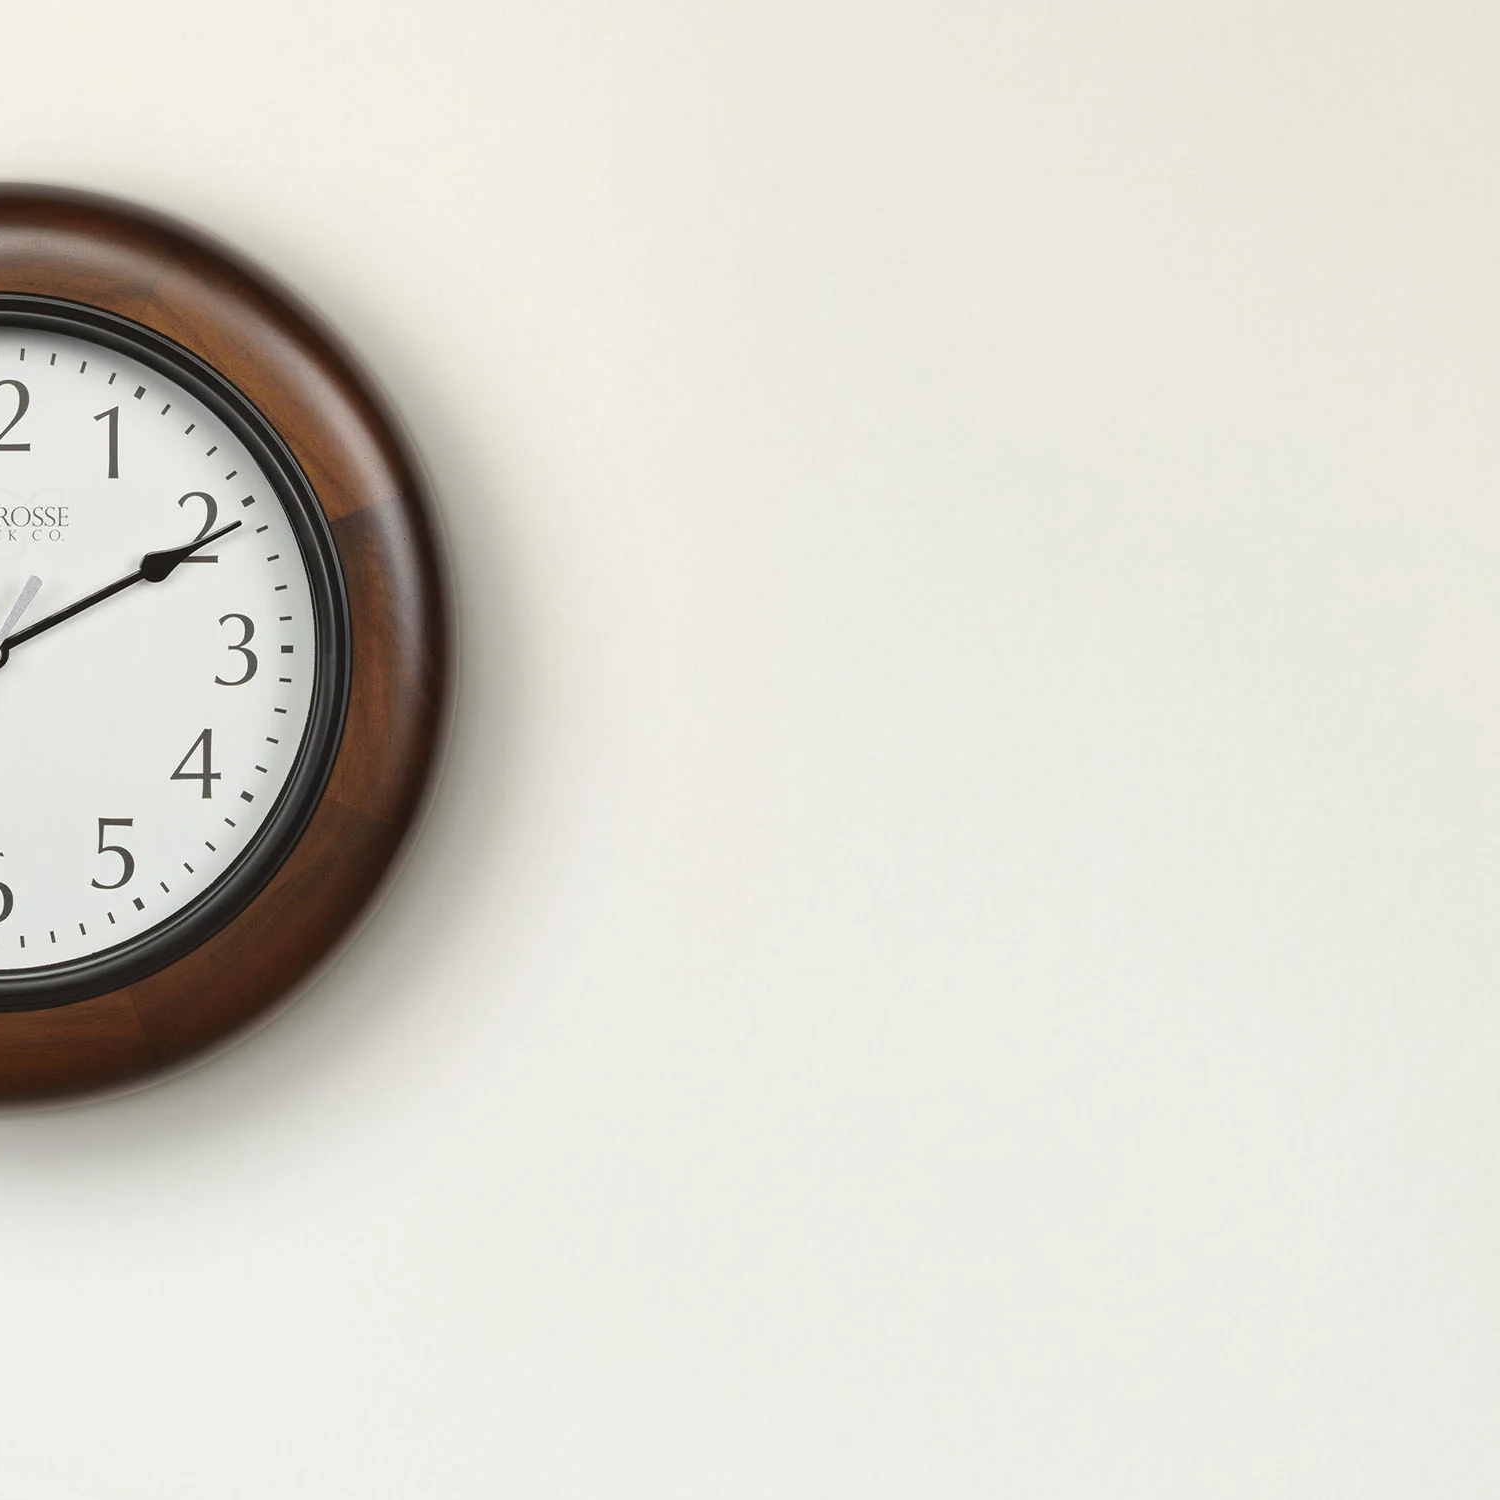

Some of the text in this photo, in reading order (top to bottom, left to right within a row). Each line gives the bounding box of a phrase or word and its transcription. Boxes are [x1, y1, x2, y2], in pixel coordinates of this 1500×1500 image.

[93, 405, 119, 479] 1
[31, 529, 66, 542] CO.
[175, 491, 219, 564] 2
[214, 613, 258, 686] 3
[169, 728, 222, 799] 4
[90, 817, 135, 890] 5
